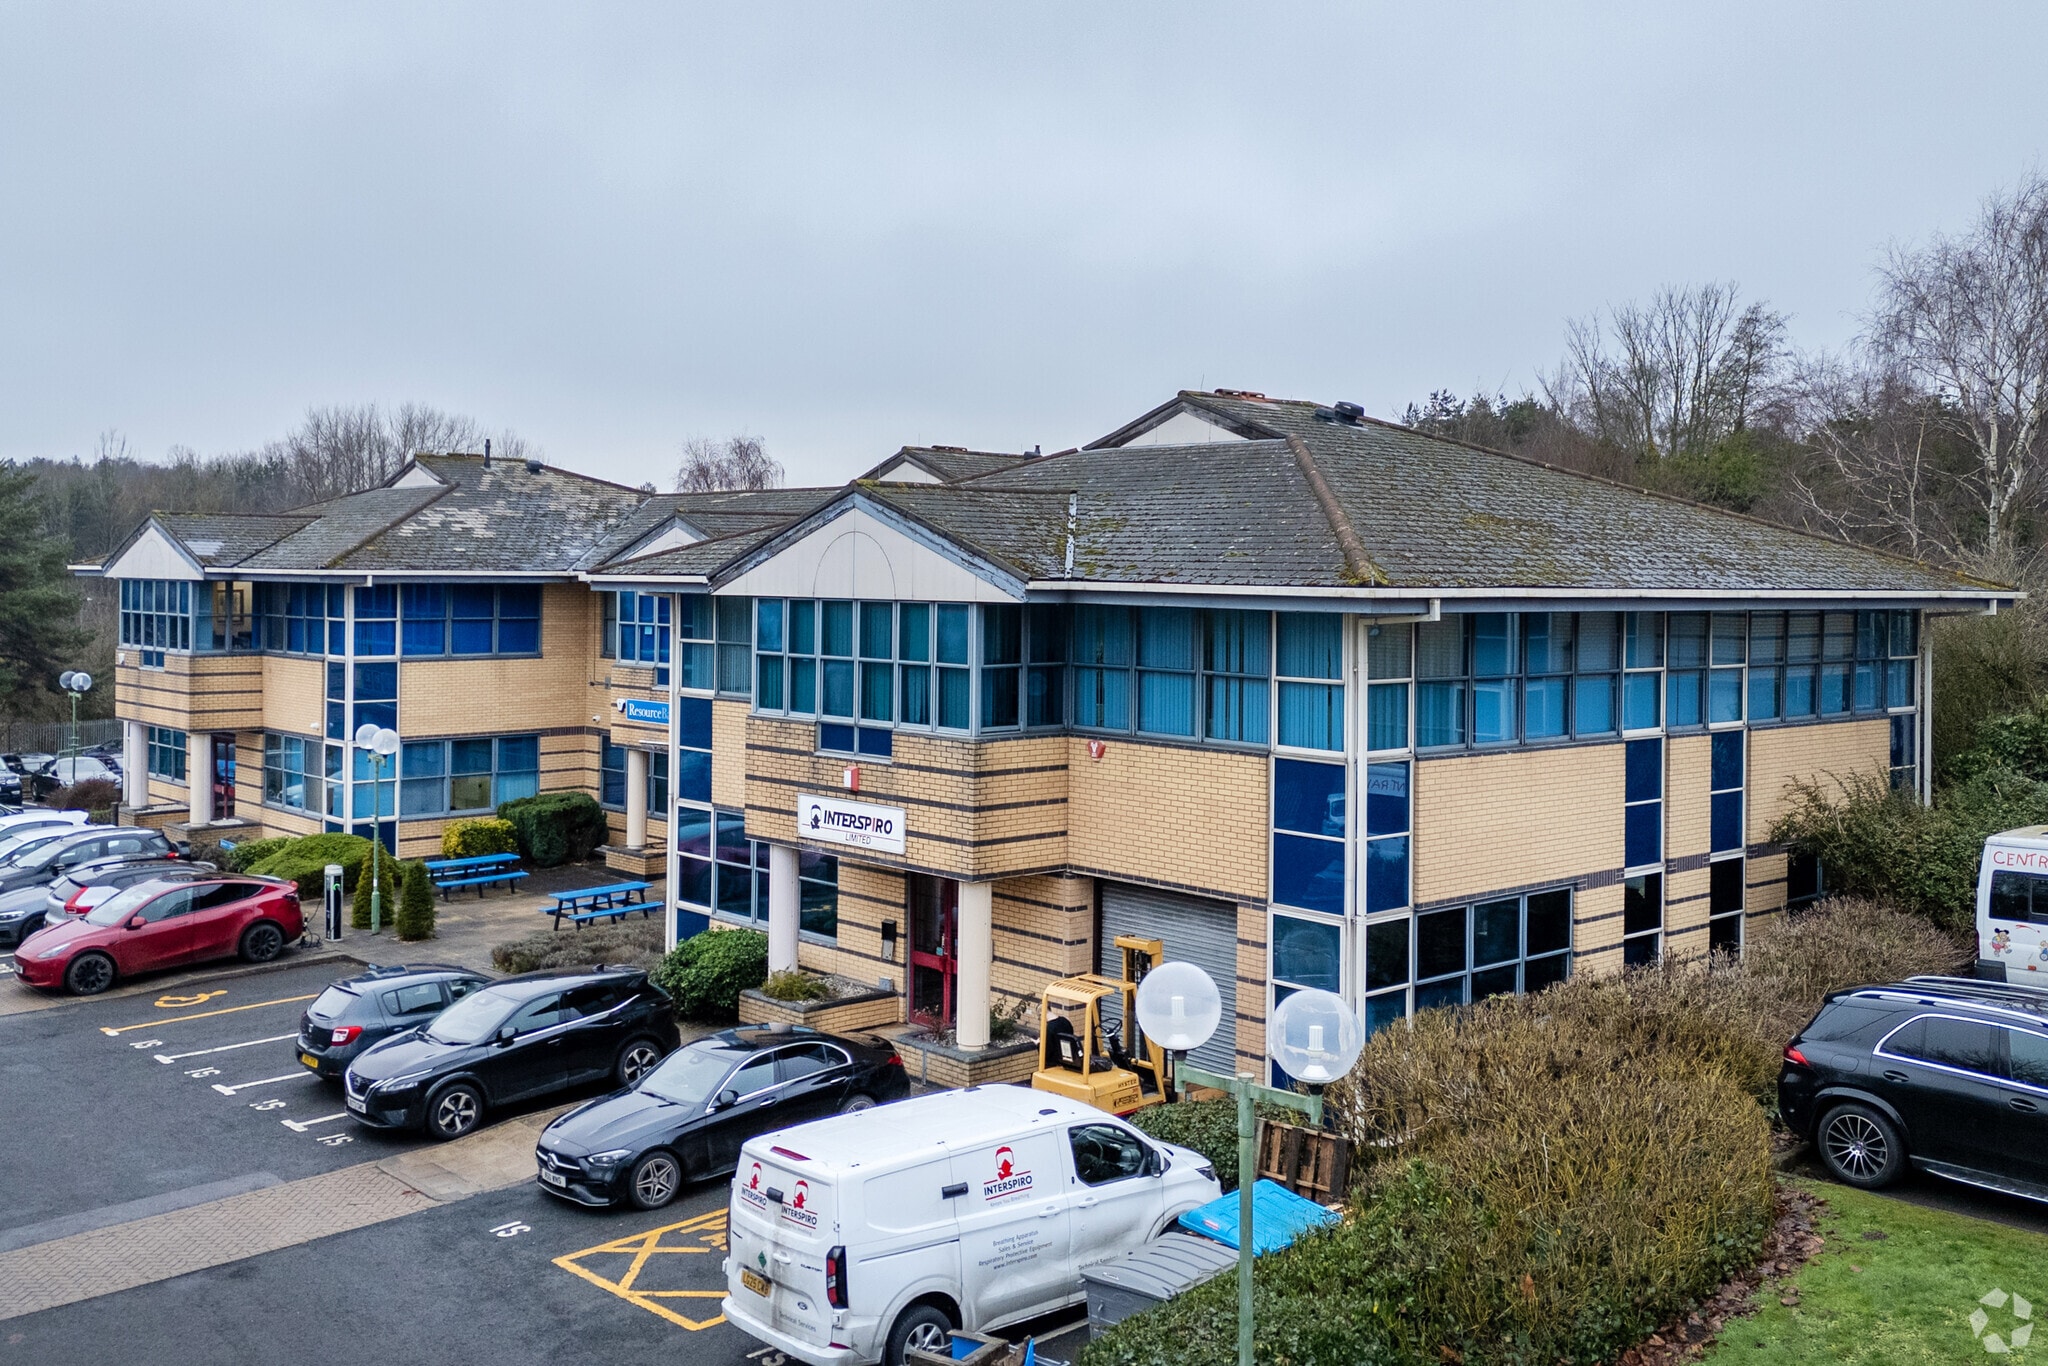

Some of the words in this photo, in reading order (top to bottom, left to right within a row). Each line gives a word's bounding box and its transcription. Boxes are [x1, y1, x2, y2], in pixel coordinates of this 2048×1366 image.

[628, 702, 669, 720] ResourceB
[823, 810, 893, 835] INTERSPIRO
[845, 832, 872, 846] LIMITED
[983, 1175, 1033, 1196] INTERSPIRO
[741, 1186, 768, 1206] INTERSPIRO
[781, 1205, 818, 1226] INTERSPIRO
[1016, 1230, 1039, 1241] Apparatus
